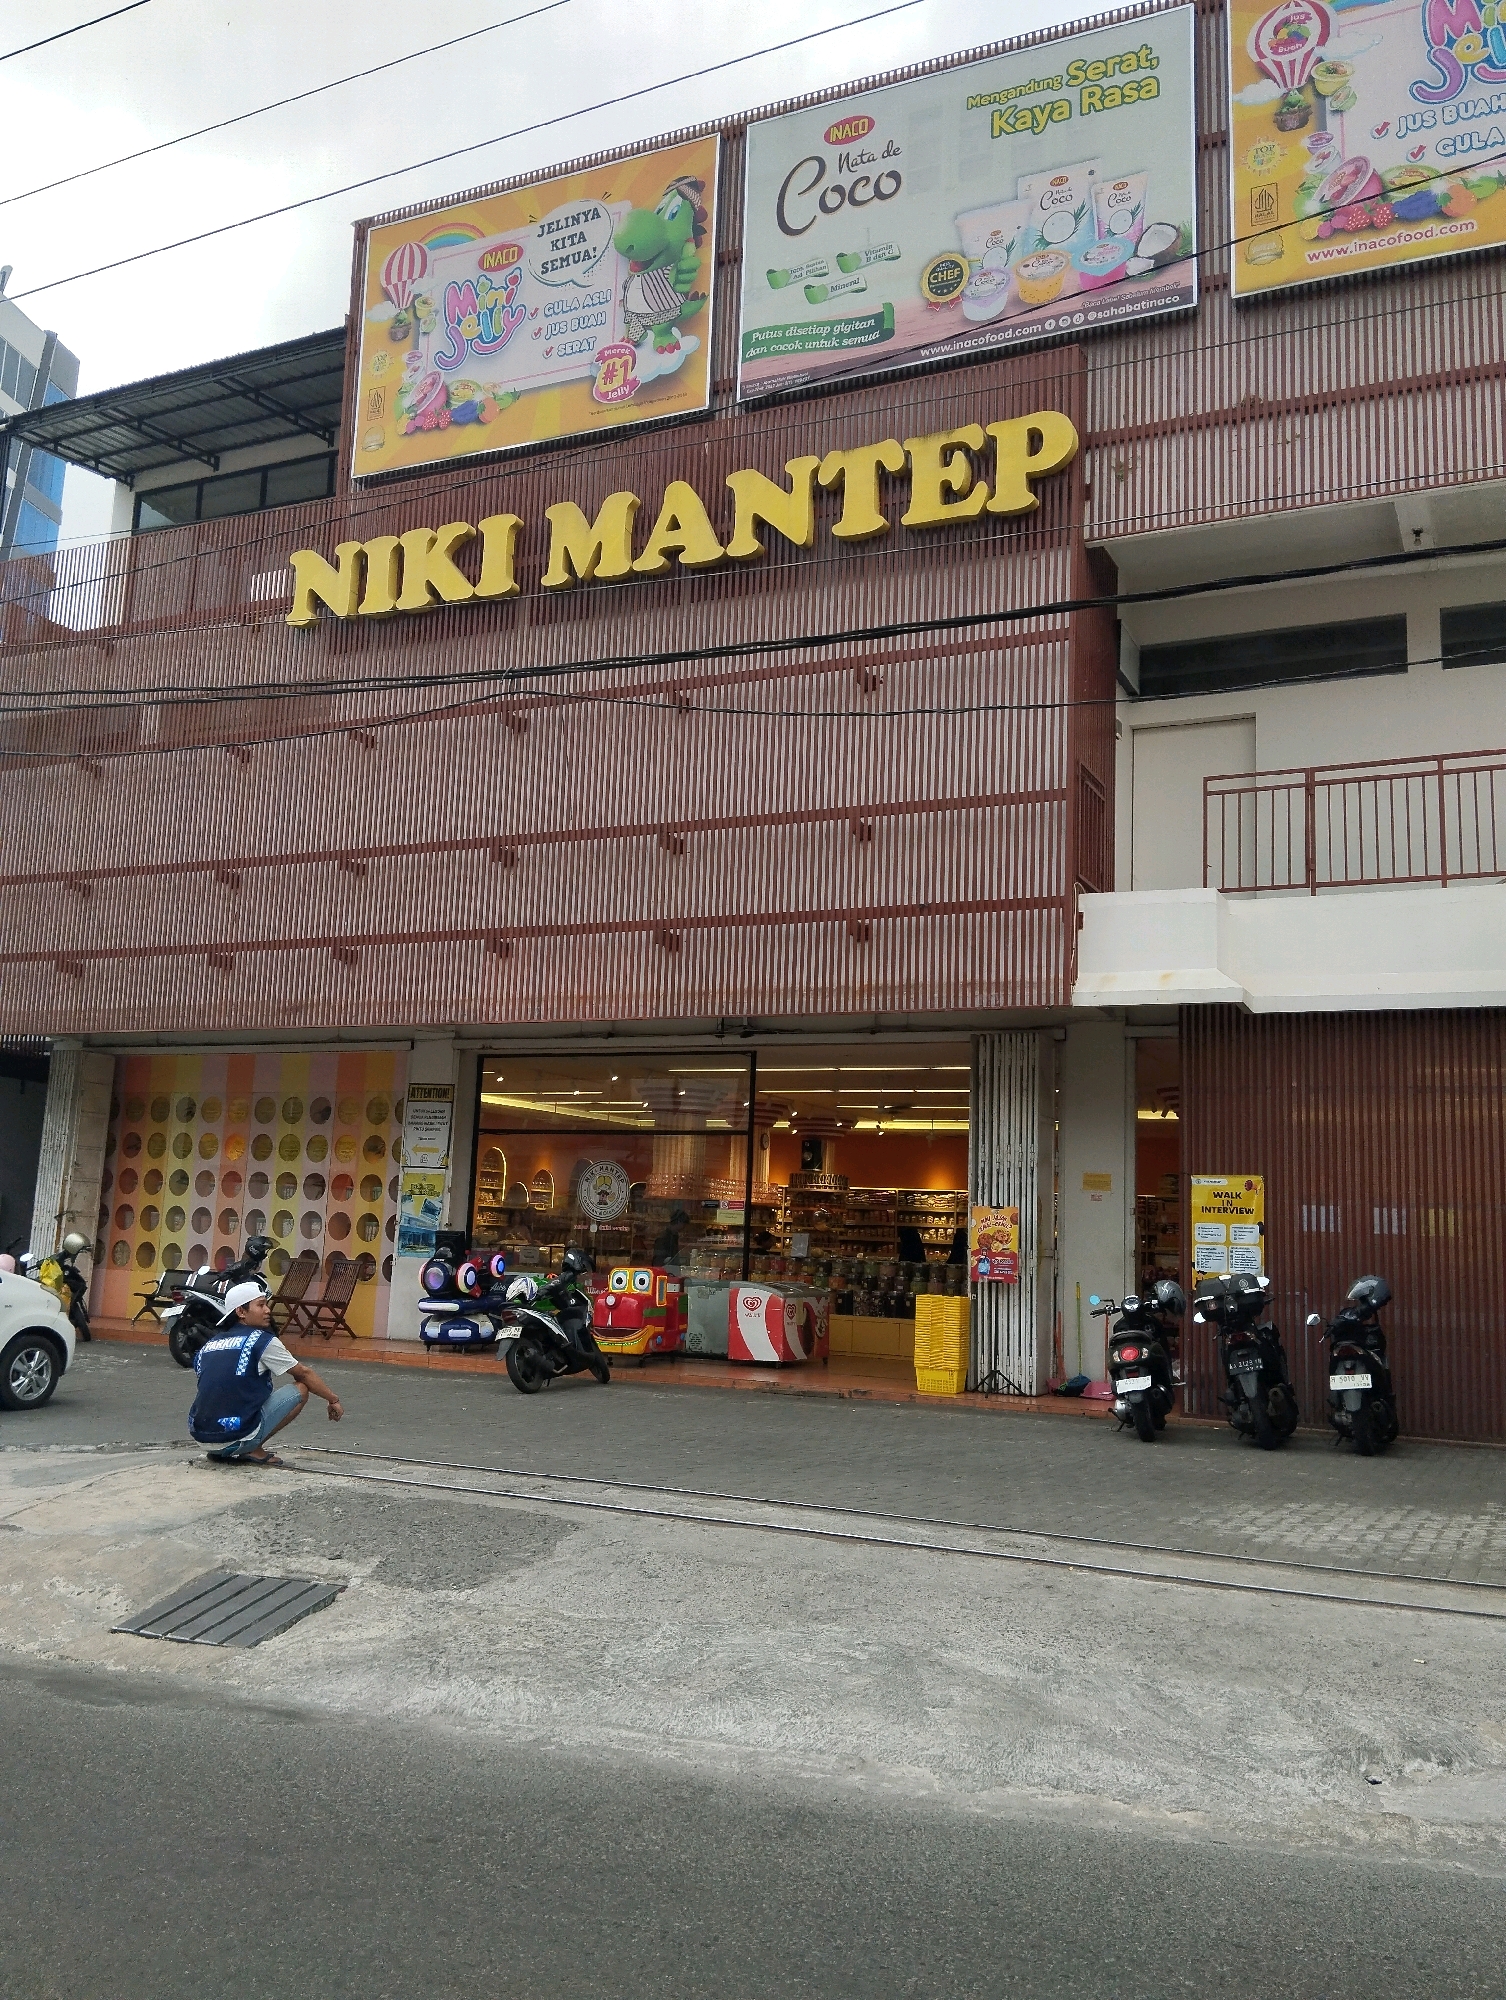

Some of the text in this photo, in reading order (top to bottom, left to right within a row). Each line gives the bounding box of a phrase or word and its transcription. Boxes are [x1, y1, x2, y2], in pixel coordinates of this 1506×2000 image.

[1426, 0, 1506, 46] Mi
[1278, 43, 1303, 53] Buah
[966, 43, 1160, 110] Mengandung Serat,
[990, 75, 1161, 139] Kaya Rasa
[1396, 93, 1506, 139] JUS BUAH
[829, 117, 870, 143] INACO
[1435, 126, 1505, 157] GULA
[838, 139, 902, 174] Nata de
[1253, 144, 1276, 155] TOP
[776, 155, 902, 236] Coco
[1040, 190, 1073, 210] Coco
[1107, 192, 1132, 208] Coco
[537, 207, 601, 238] JELINYA
[550, 230, 588, 252] KITA
[864, 243, 893, 258] Vitamin
[1307, 220, 1475, 262] www.inacofood.com
[483, 246, 519, 270] INACO
[540, 246, 598, 275] SEMUA!
[830, 277, 860, 293] Mineral
[929, 267, 961, 284] CHEF
[445, 268, 522, 326] Mini
[544, 289, 612, 318] GULA ASLI
[545, 311, 606, 340] JUS BUAH
[750, 317, 875, 344] Putus disetiap gigitan
[920, 294, 1180, 358] www.inacofood.com @sahabatinaco
[557, 336, 597, 357] SERAT
[604, 347, 631, 357] Merek
[745, 330, 881, 359] dan cocok untuk semua
[602, 359, 629, 385] #1
[606, 385, 630, 400] Jelly
[286, 410, 1080, 629] NIKI MANTEP
[410, 1086, 451, 1099] ATTENTION!
[1213, 1191, 1242, 1199] WALK
[1201, 1206, 1254, 1215] INTERVIEW
[204, 1336, 243, 1351] PARKIR
